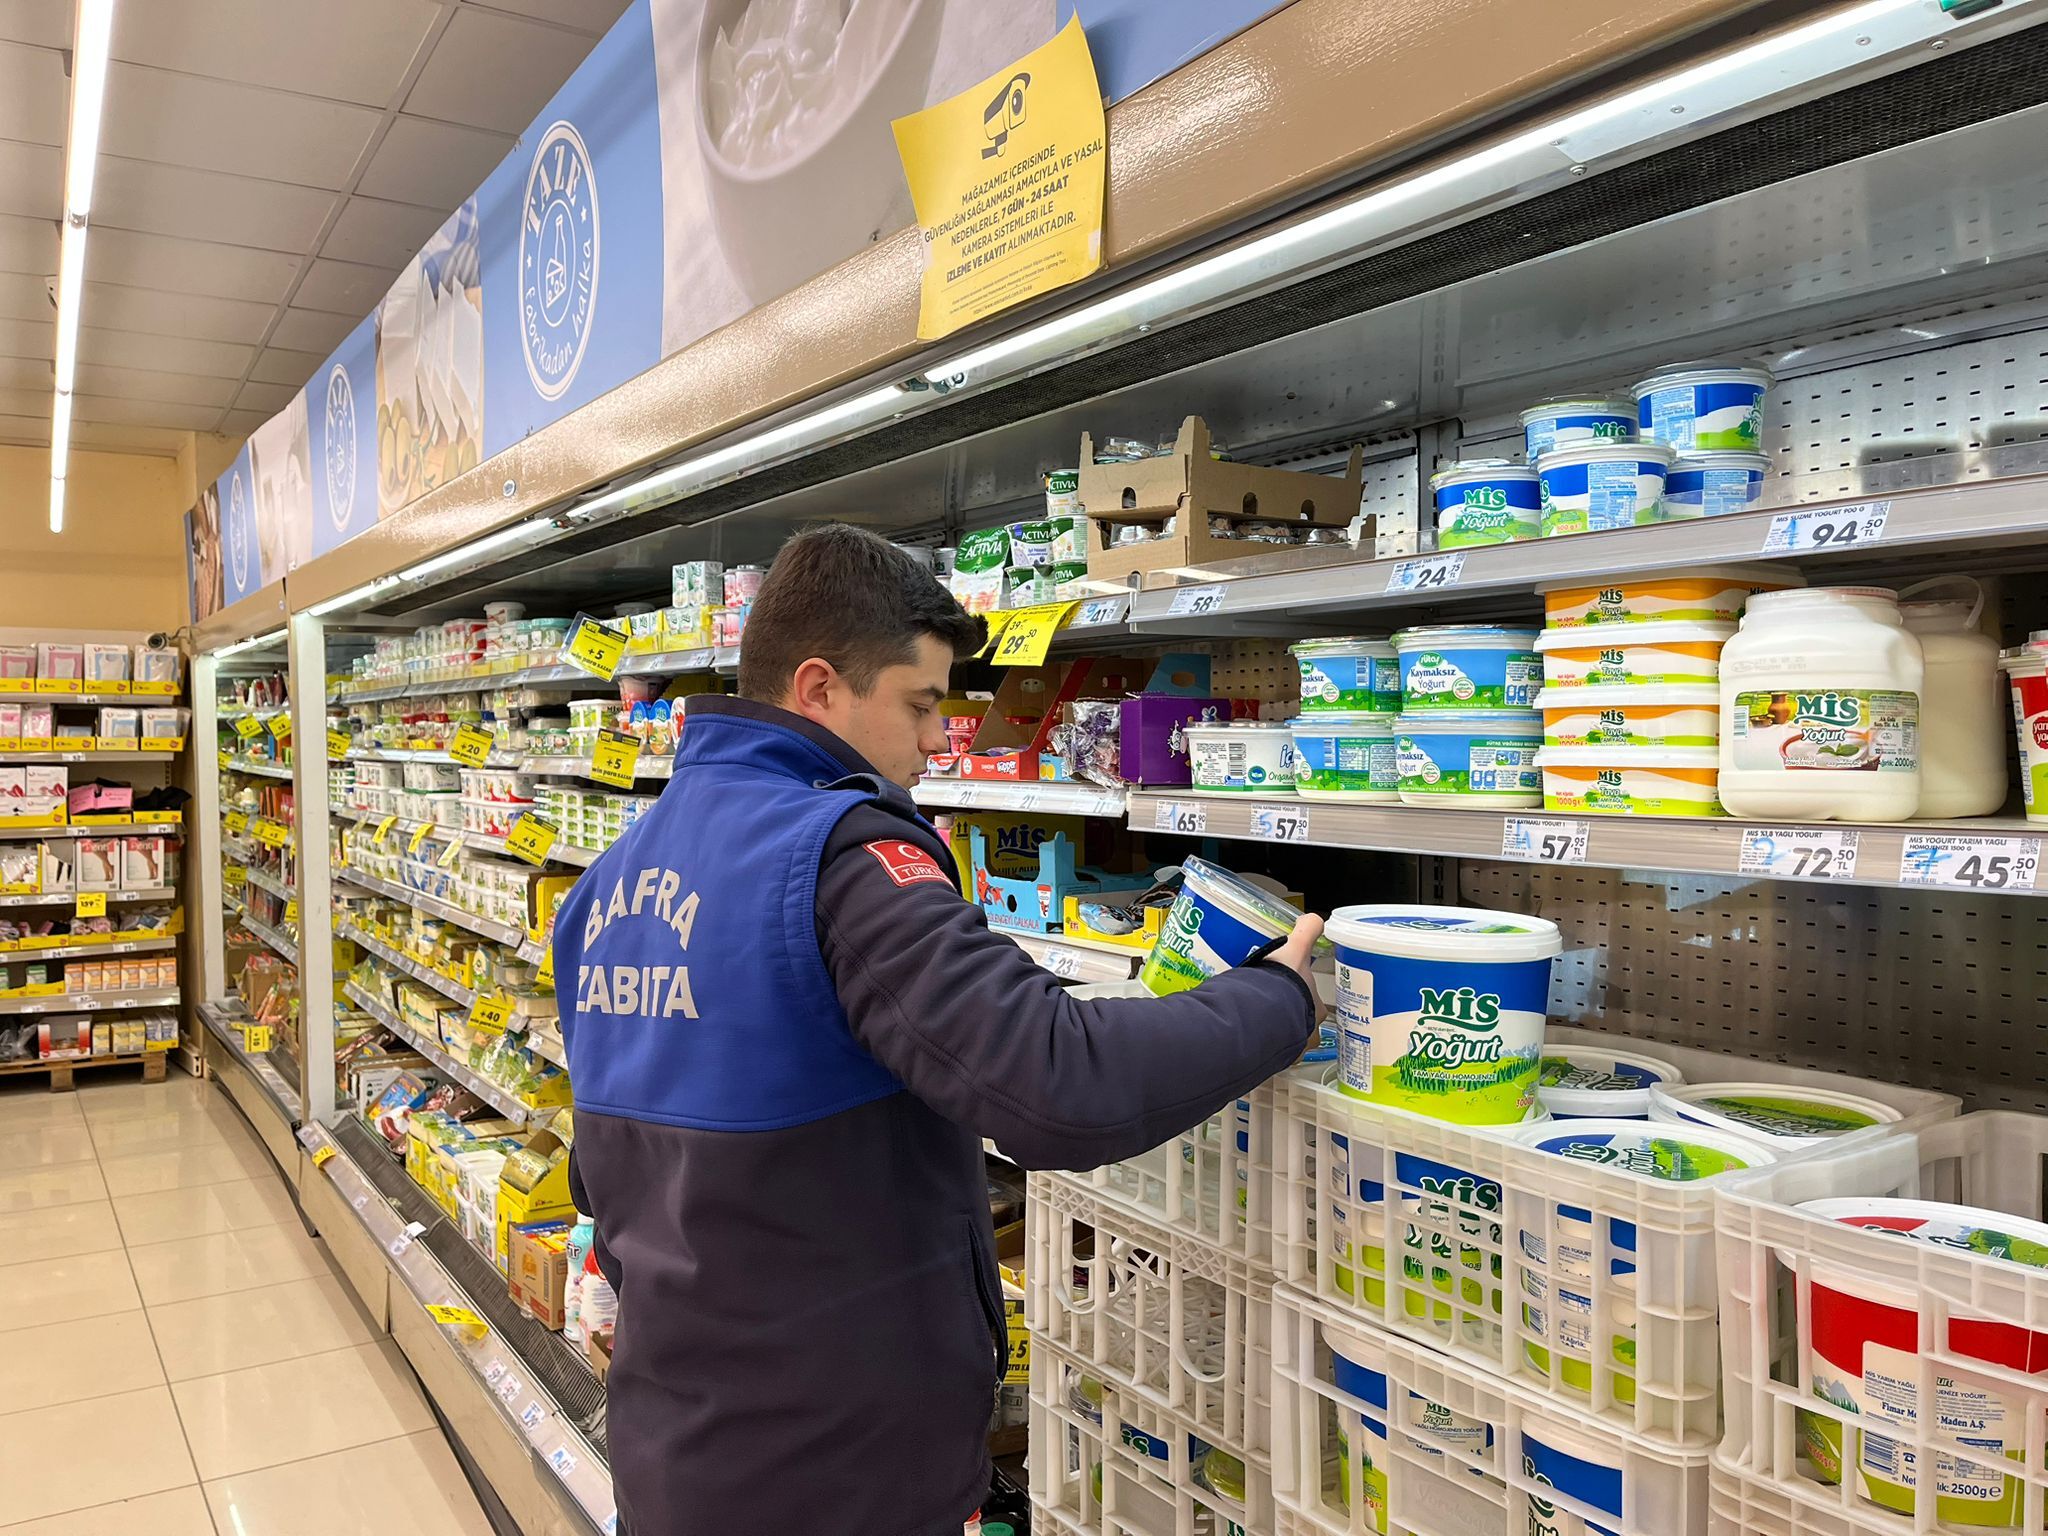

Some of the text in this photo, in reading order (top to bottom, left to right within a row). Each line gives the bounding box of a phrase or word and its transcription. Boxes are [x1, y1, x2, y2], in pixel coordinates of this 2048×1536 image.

[961, 171, 1008, 205] MAĞAZAMIZ
[966, 188, 1015, 221] SAĞLANMASI
[1015, 166, 1059, 197] AMACIYLA
[1059, 156, 1073, 173] VE
[1074, 138, 1103, 167] YASAL
[527, 145, 581, 238] TAZE
[951, 215, 1000, 246] NEDENLERLE,
[1001, 207, 1008, 220] 7
[1007, 196, 1026, 217] GÜN
[1030, 190, 1043, 204] 24
[1043, 175, 1069, 199] SAAT
[961, 201, 1054, 258] KAMERA SİSTEMLERİ İLE
[972, 255, 983, 269] VE
[983, 242, 1007, 264] KAYIT
[1008, 211, 1076, 252] ALINMAKTADIR.
[572, 237, 591, 339] halka
[1814, 509, 1842, 519] YOGURT
[1812, 520, 1858, 549] 94
[1864, 529, 1875, 537] TL
[964, 541, 1003, 559] ACTIVIA
[1414, 566, 1447, 589] 24
[1191, 596, 1214, 613] 58
[1090, 609, 1108, 623] 41
[1002, 635, 1026, 655] 29
[1410, 667, 1457, 678] Kaymaksız
[1417, 679, 1446, 690] Yoğurt
[1801, 728, 1846, 744] Yoğurt
[1177, 812, 1197, 832] 65
[1275, 818, 1297, 840] 57
[1746, 829, 1759, 837] MIS
[1794, 831, 1823, 839] YOGURT
[1908, 836, 1923, 845] MIS
[1923, 837, 1956, 846] YOGURT
[1957, 838, 1983, 846] YARIM
[1540, 835, 1572, 860] 57
[1574, 847, 1582, 856] TL
[1949, 844, 1965, 852] 1500
[1792, 847, 1833, 877] 72
[1837, 861, 1848, 870] TL
[1955, 854, 2012, 888] 45
[2015, 870, 2028, 880] TL
[583, 867, 701, 953] BAFRA
[1162, 921, 1194, 958] oğurt
[1054, 957, 1072, 976] 23
[575, 964, 701, 1019] ZABITA
[1409, 1031, 1503, 1070] Yoğurt
[1412, 1069, 1429, 1078] TAM
[1430, 1070, 1451, 1080] YAĞLI
[1876, 1374, 1896, 1384] YARIM
[1960, 1391, 1987, 1400] YOĞURT
[1423, 1414, 1454, 1427] Yoğurt
[1940, 1415, 1986, 1430] Maden A.Ş.
[1950, 1482, 1987, 1499] 2500g
